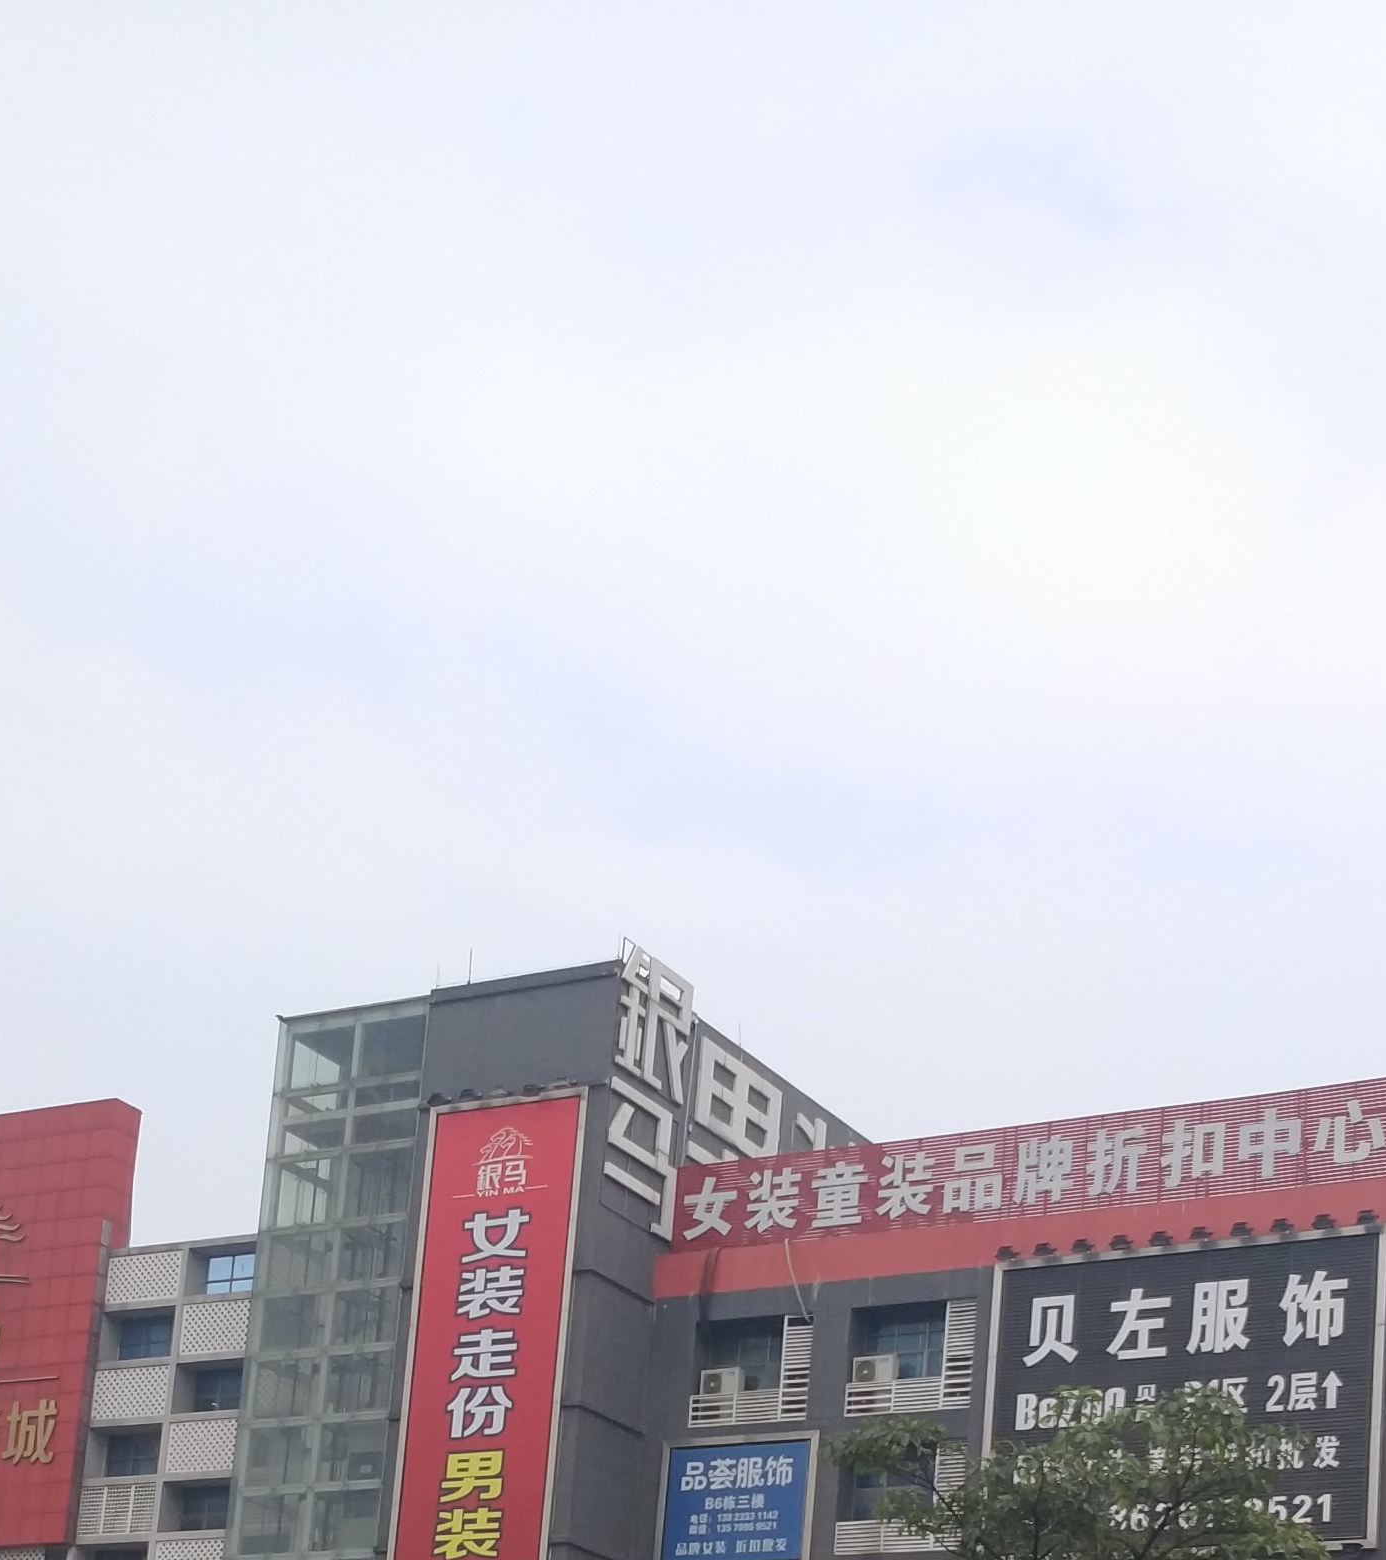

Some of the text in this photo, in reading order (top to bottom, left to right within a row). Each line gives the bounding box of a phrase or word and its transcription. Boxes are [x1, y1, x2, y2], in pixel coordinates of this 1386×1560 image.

[603, 941, 694, 1241] 银马
[477, 1160, 526, 1191] 银马
[503, 1185, 525, 1195] MA
[683, 1101, 1386, 1240] 女装童装品牌折扣中心
[1022, 1270, 1350, 1368] 贝左服饰
[680, 1454, 795, 1492] 品荟服饰
